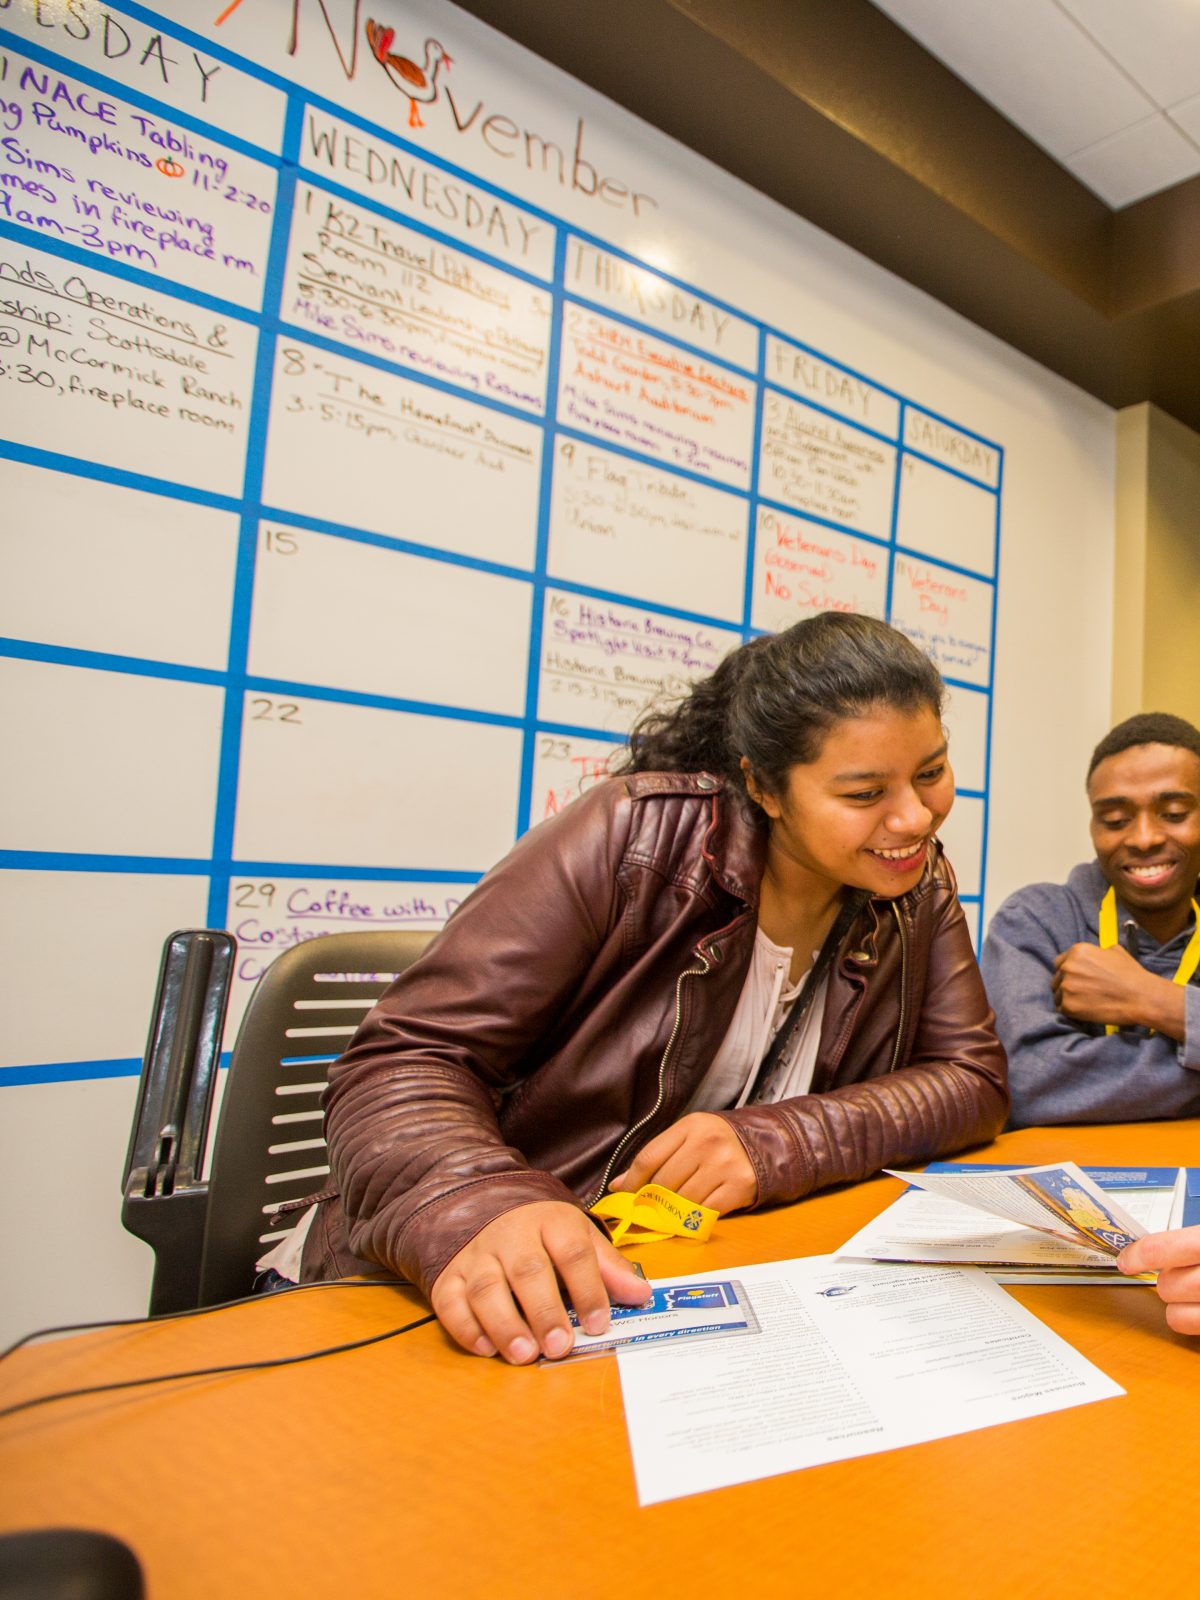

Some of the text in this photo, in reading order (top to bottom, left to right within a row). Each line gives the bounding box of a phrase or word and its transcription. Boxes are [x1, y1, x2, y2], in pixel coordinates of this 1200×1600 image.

[0, 0, 221, 102] ESDAY
[20, 66, 118, 126] NACE
[130, 115, 229, 184] Tabling
[32, 102, 153, 168] Pumpkins
[1, 137, 215, 247] Sims reviewing
[309, 114, 540, 255] WEDNESDAY
[72, 194, 101, 221] in
[111, 203, 216, 261] fireplace
[222, 254, 258, 277] rm
[305, 190, 312, 215] 1
[325, 202, 362, 239] K2
[366, 225, 435, 274] Travel
[317, 231, 388, 275] Room
[302, 252, 403, 304] Servant
[63, 276, 198, 341] Operations
[206, 324, 229, 349] &
[293, 298, 336, 330] Mike
[27, 334, 167, 389] McCormick
[180, 375, 243, 410] Ranch
[87, 317, 210, 374] Scottsdale
[283, 347, 306, 377] 8
[70, 375, 169, 418] fireplace
[178, 407, 235, 433] room
[775, 343, 873, 417] FRIDAY
[560, 442, 576, 468] 9
[909, 413, 993, 476] SATURDAY
[264, 529, 299, 556] 15
[775, 520, 846, 564] Veterans
[765, 571, 792, 602] No
[252, 697, 303, 726] 22
[541, 738, 571, 760] 23
[235, 883, 276, 909] 29
[287, 888, 374, 917] Coffee
[382, 896, 437, 919] with
[677, 1292, 720, 1301] Flagstaff
[635, 1334, 646, 1343] in
[647, 1331, 677, 1342] every
[678, 1325, 722, 1335] direction
